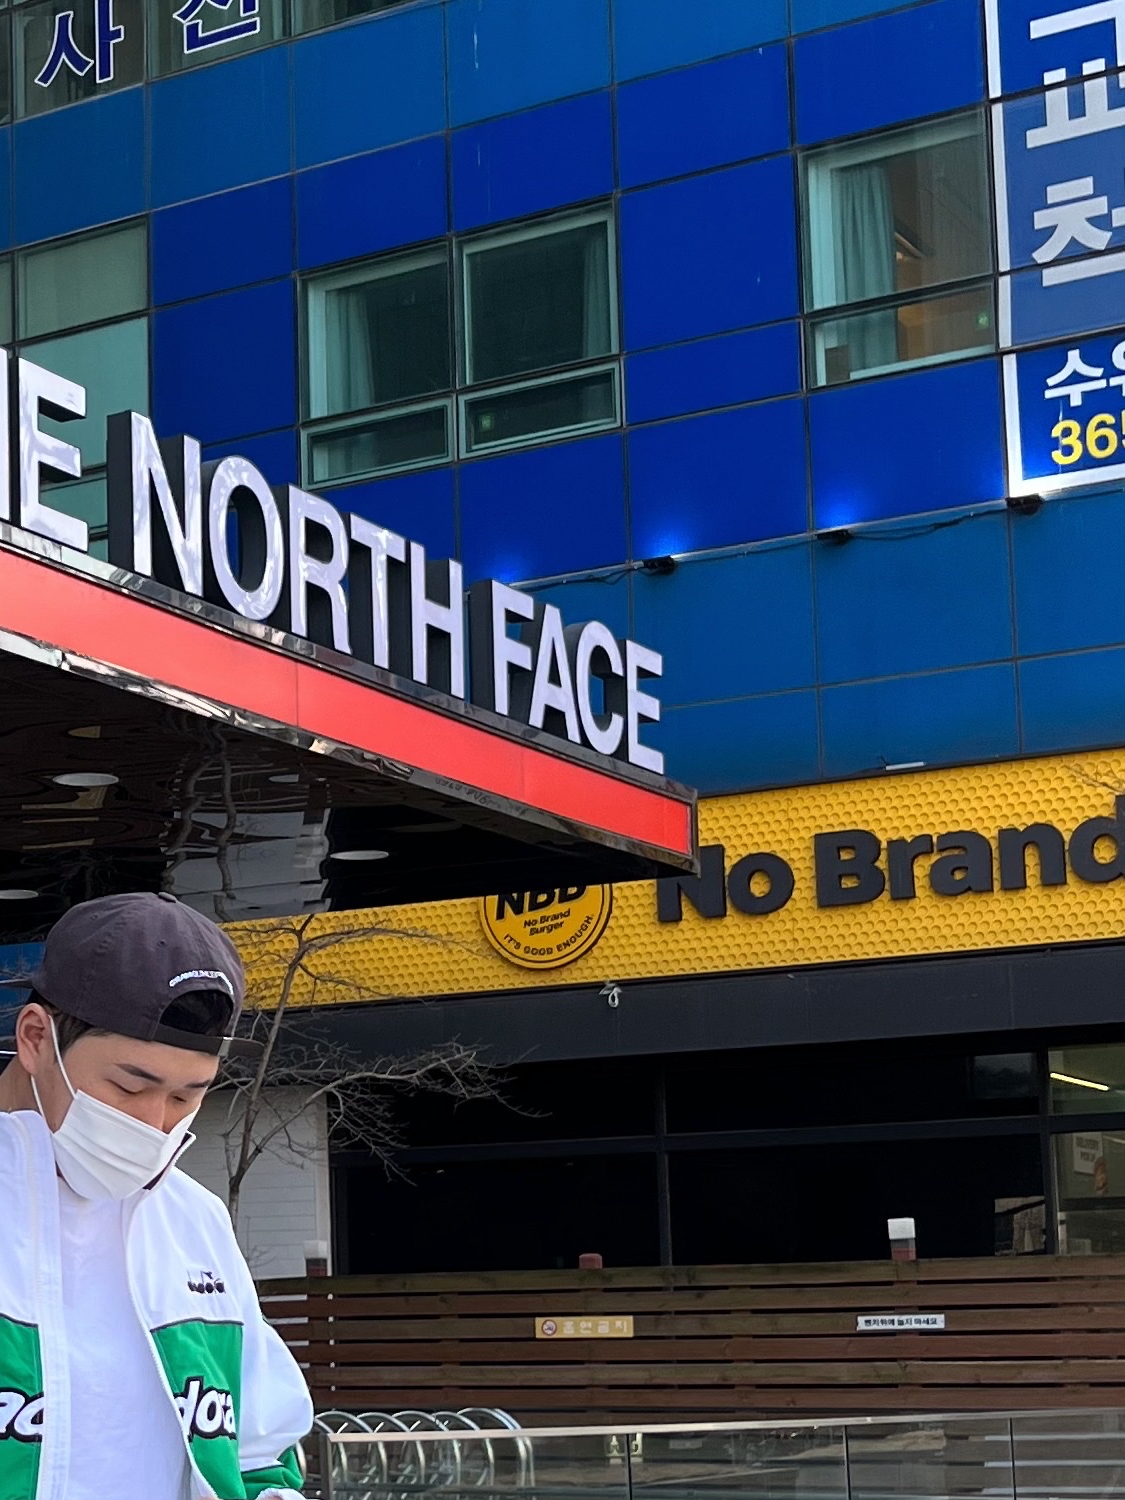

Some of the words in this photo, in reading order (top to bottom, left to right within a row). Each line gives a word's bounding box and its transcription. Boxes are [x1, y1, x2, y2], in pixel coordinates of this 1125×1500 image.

[1044, 339, 1125, 407] 수
[1051, 409, 1125, 465] 36
[130, 410, 465, 699] NORTH
[489, 578, 667, 775] FACE
[656, 843, 795, 923] No
[814, 794, 1125, 909] Brand
[523, 918, 539, 929] No
[539, 907, 572, 924] Brand
[529, 920, 564, 936] Burger
[523, 946, 553, 956] GOOD
